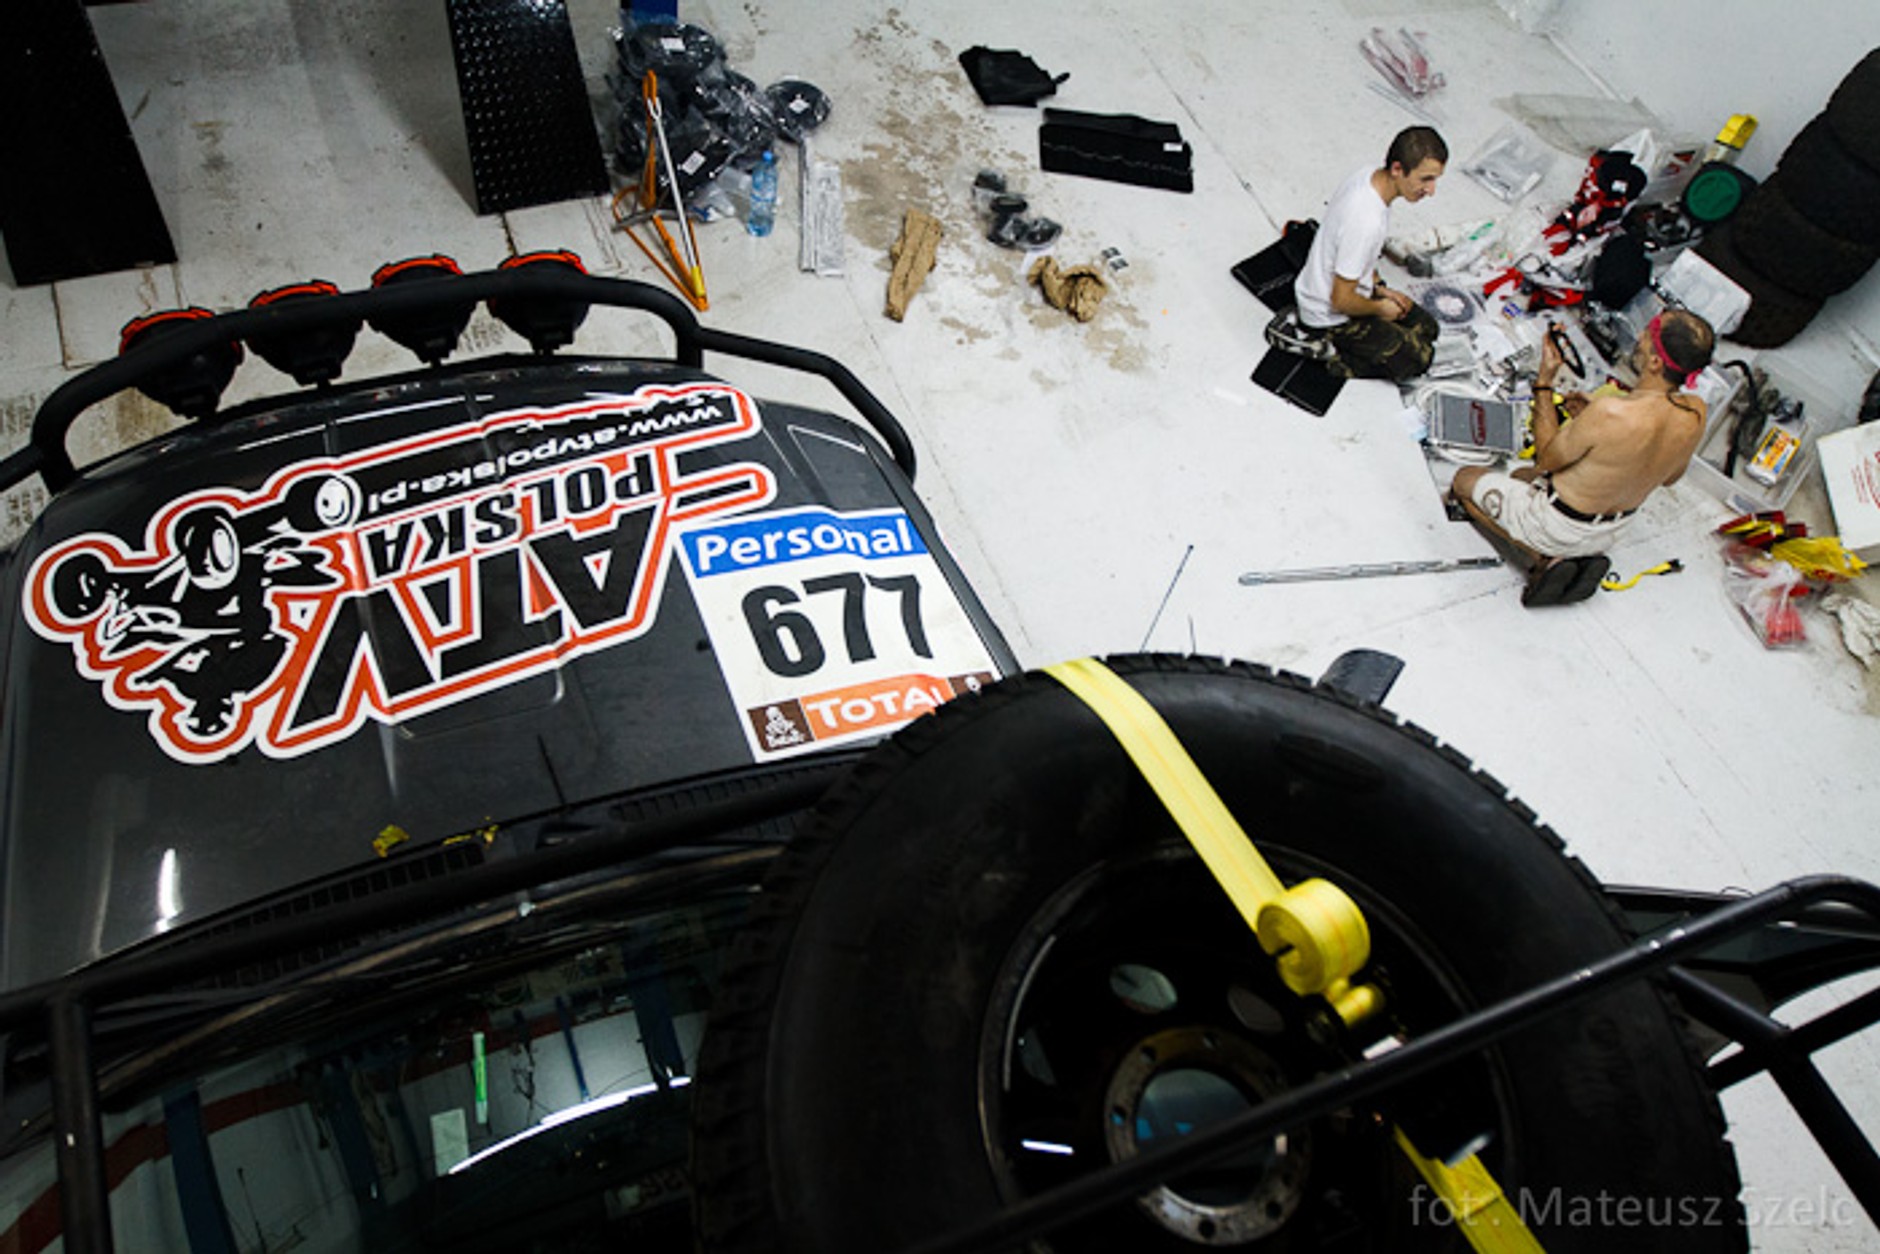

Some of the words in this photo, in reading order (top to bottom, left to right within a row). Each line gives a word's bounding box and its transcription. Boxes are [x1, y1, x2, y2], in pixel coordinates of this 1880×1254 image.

[368, 405, 723, 514] www.atvpolska.pl
[367, 453, 655, 578] POLSKA
[695, 517, 913, 573] Personal
[289, 504, 657, 731] ATV
[741, 571, 934, 679] 677
